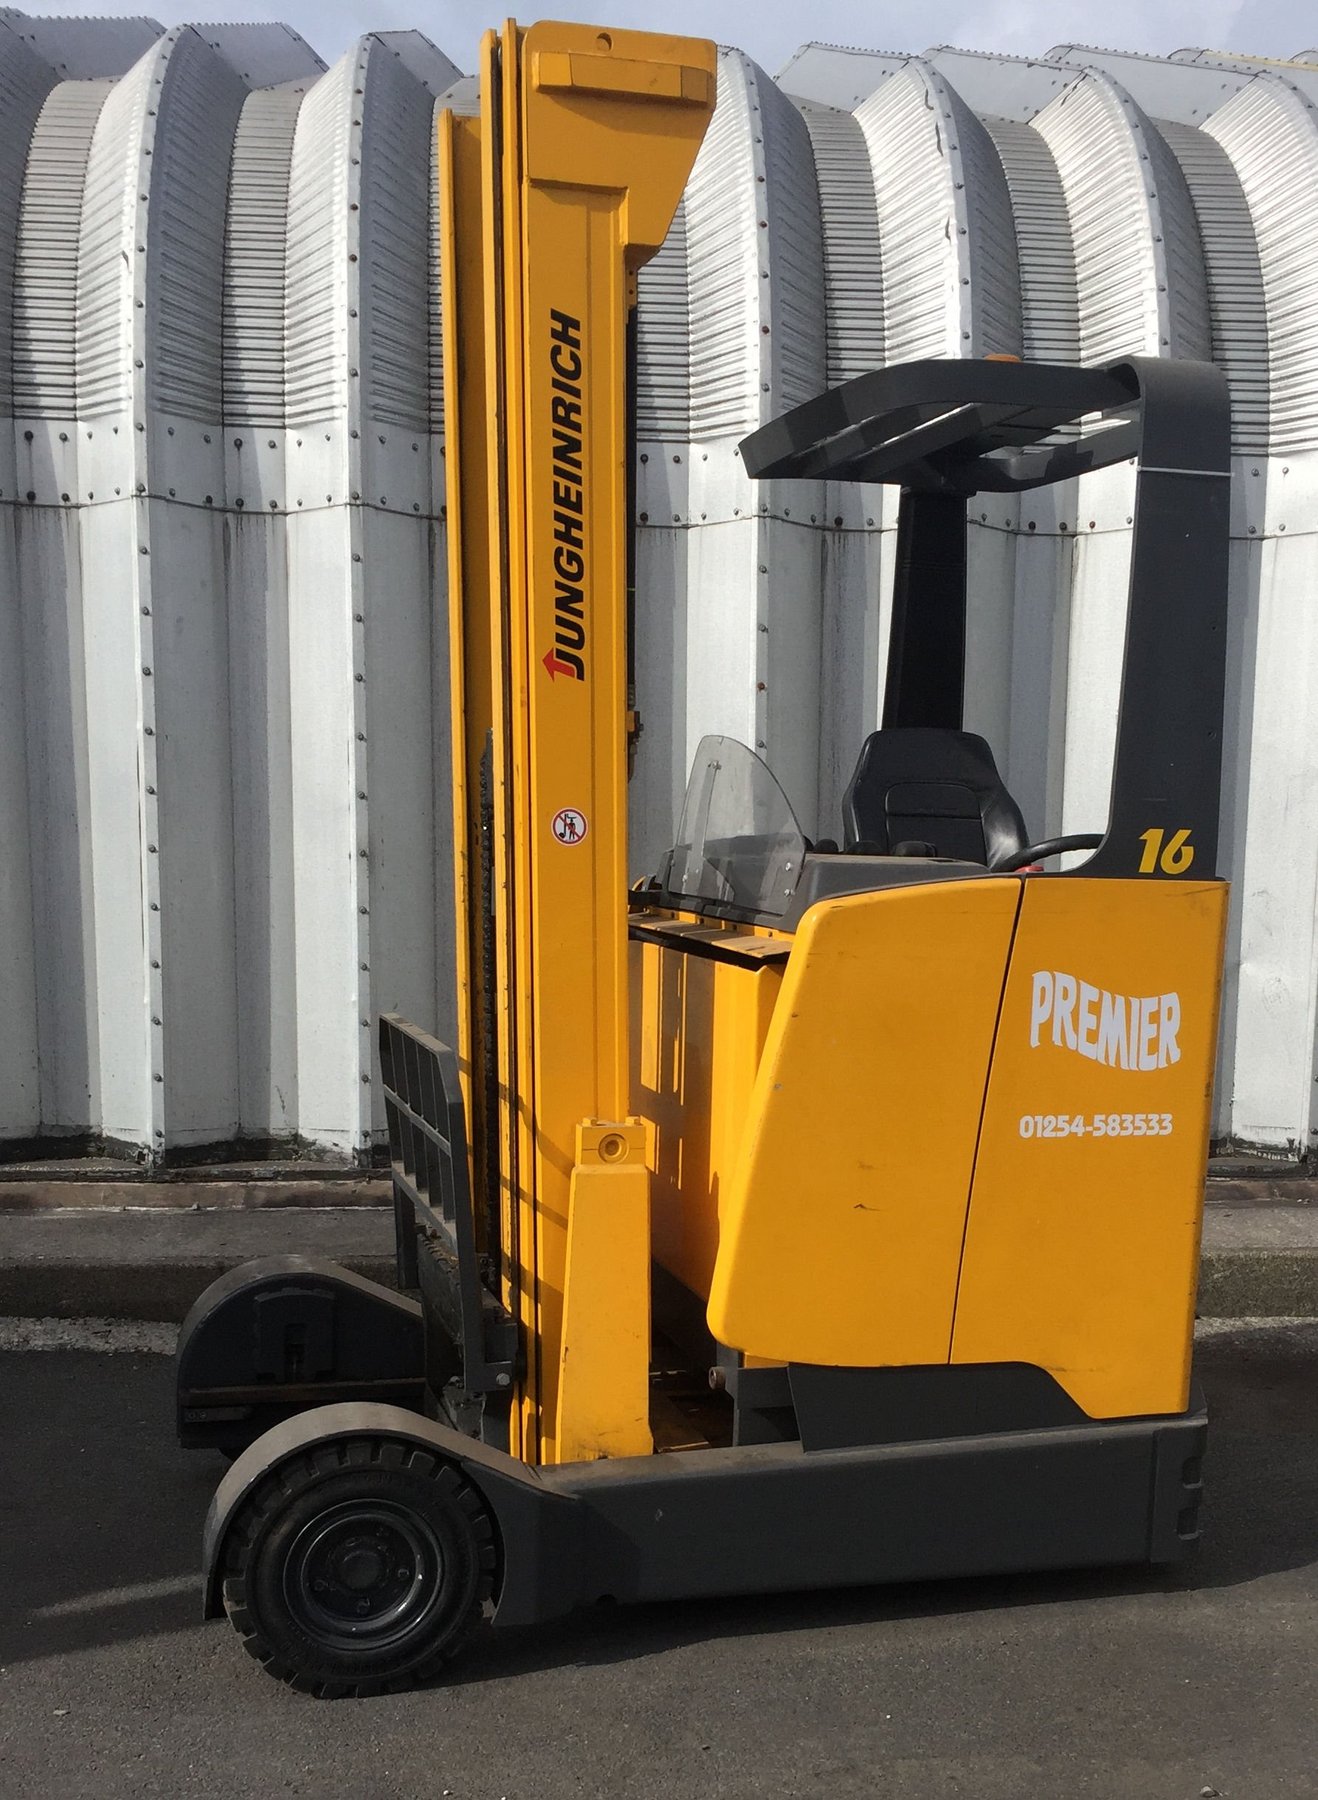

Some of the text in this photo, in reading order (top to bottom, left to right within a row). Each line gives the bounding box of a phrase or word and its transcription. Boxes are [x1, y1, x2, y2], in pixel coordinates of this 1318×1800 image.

[544, 309, 584, 682] JUNGHEINRICH
[1139, 828, 1194, 875] 16
[1030, 971, 1181, 1071] PREMIER
[1019, 1113, 1173, 1138] 01254-583533
